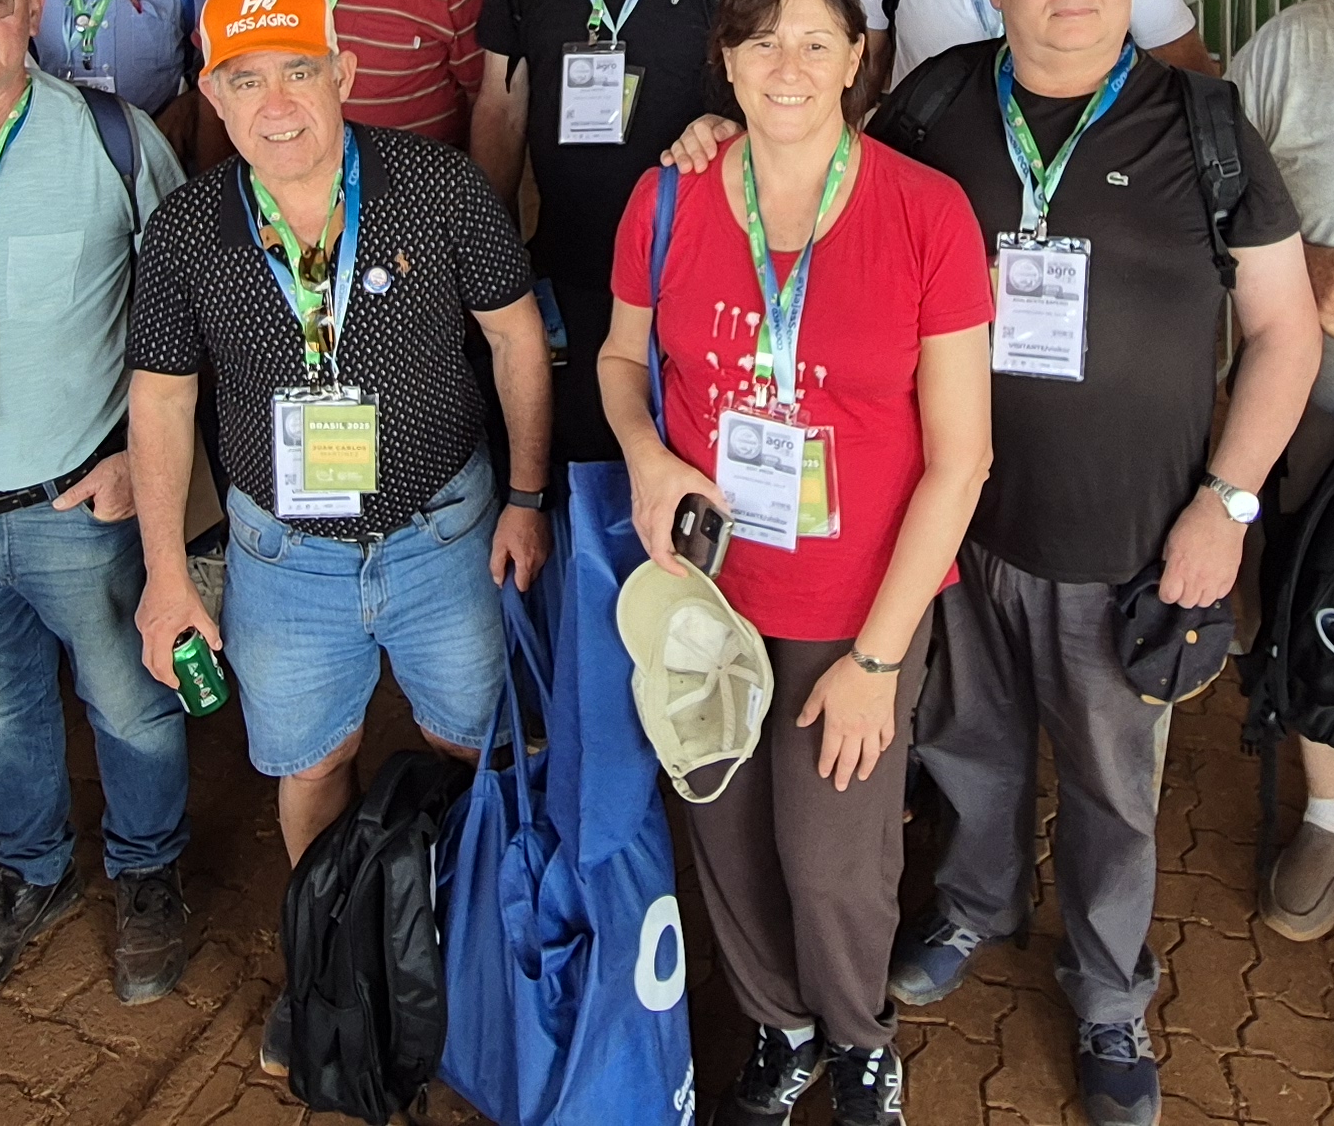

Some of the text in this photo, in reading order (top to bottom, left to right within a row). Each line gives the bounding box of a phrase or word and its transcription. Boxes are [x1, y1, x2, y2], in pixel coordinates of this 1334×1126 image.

[256, 13, 299, 28] AGRO
[1046, 265, 1077, 279] agro
[309, 422, 345, 430] BRASIL
[765, 435, 795, 451] agro
